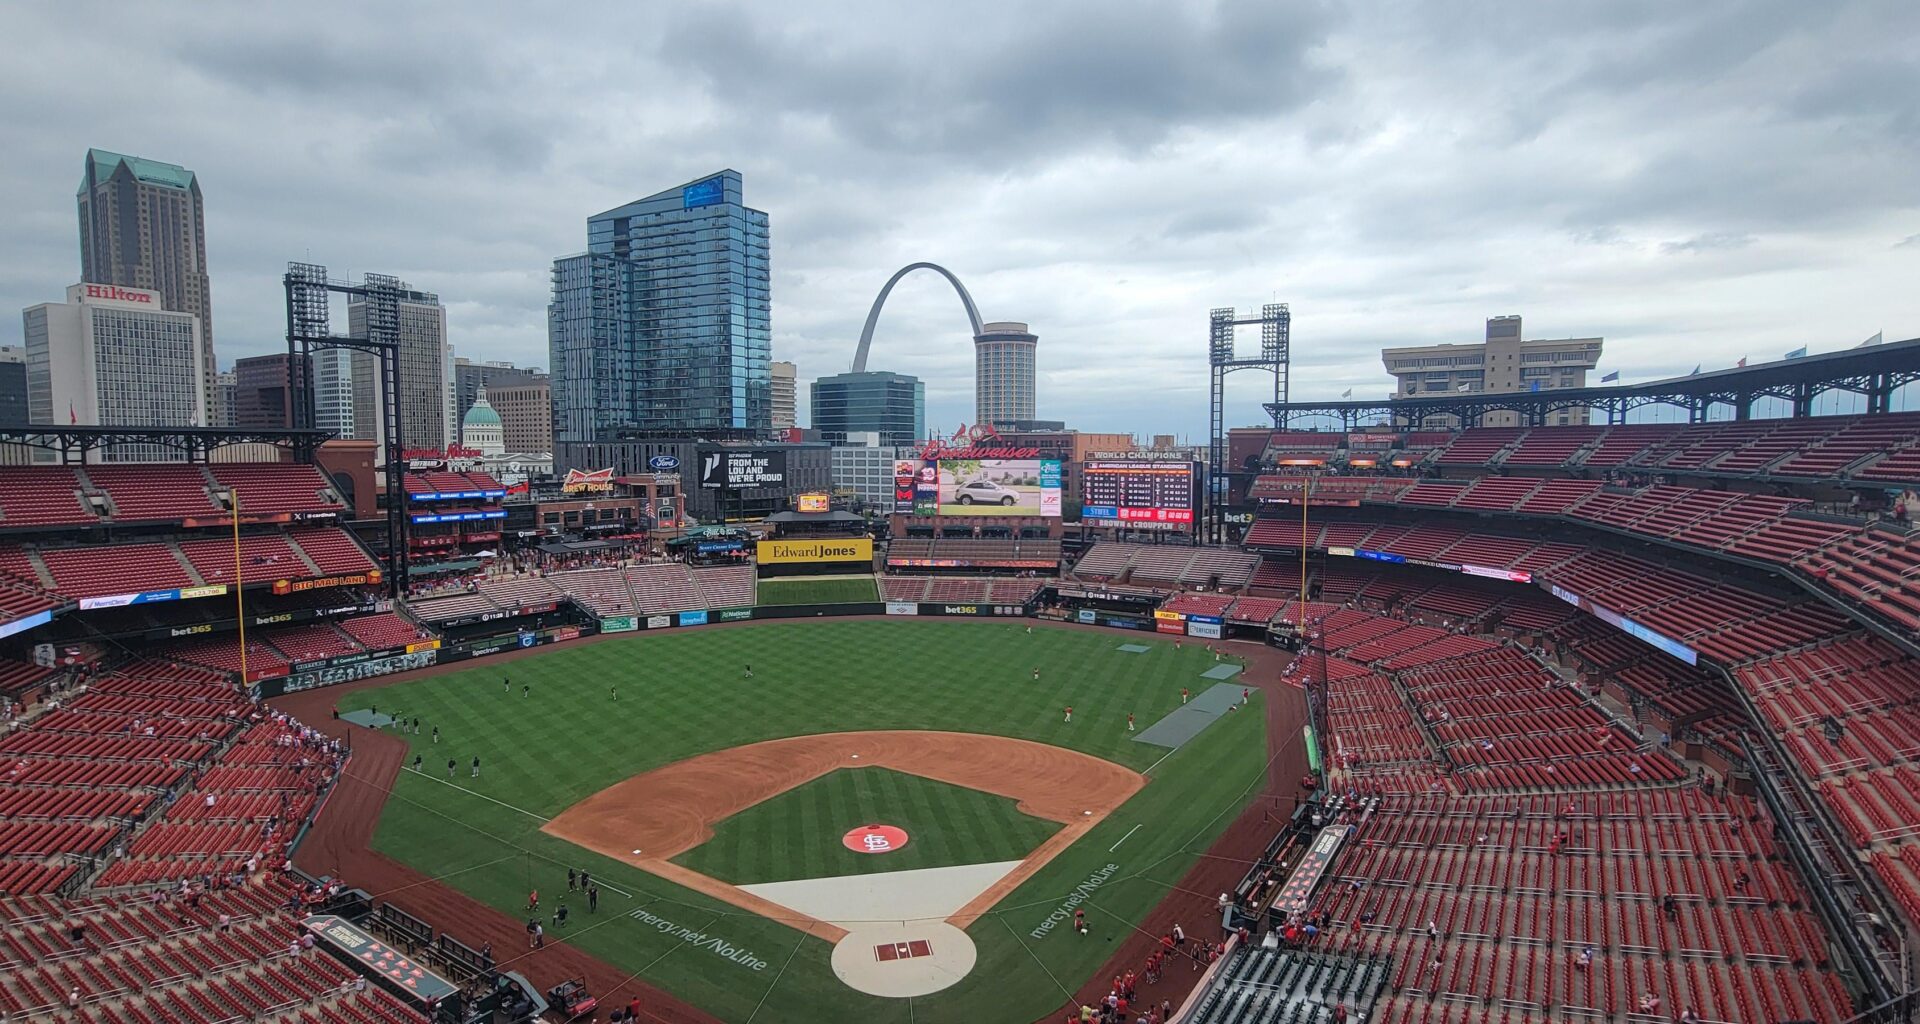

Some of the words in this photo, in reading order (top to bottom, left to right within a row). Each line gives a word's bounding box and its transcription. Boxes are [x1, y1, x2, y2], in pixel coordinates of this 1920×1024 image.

[86, 284, 152, 303] Hilton
[914, 440, 1041, 460] Budweiser
[1094, 451, 1126, 460] WORLD
[1127, 451, 1183, 460] CHAMPIONS
[656, 457, 675, 467] Ford
[728, 459, 752, 467] FROM
[752, 459, 769, 467] THE
[728, 467, 745, 475] LOU
[745, 467, 763, 475] AND
[728, 474, 754, 483] WE'RE
[755, 473, 783, 482] PROUD
[564, 483, 587, 493] BREW
[587, 482, 614, 491] HOUSE
[1099, 520, 1125, 528] BROWN
[1133, 521, 1173, 530] CROUPPEN
[773, 546, 817, 557] Edward
[818, 545, 856, 557] Jones
[1405, 558, 1435, 566] LINDENWOOD
[1436, 562, 1461, 571] UNIVERSITY
[292, 581, 313, 591] BIG
[314, 578, 339, 588] MAC
[340, 575, 366, 585] LAND
[1562, 589, 1579, 606] LOUIS
[945, 606, 977, 614] bet365
[256, 614, 292, 625] bet365
[171, 625, 212, 637] bet365
[472, 646, 500, 657] Spectrum
[1030, 863, 1119, 939] mercy.net/NoLine
[629, 909, 768, 971] mercy.net/NoLine
